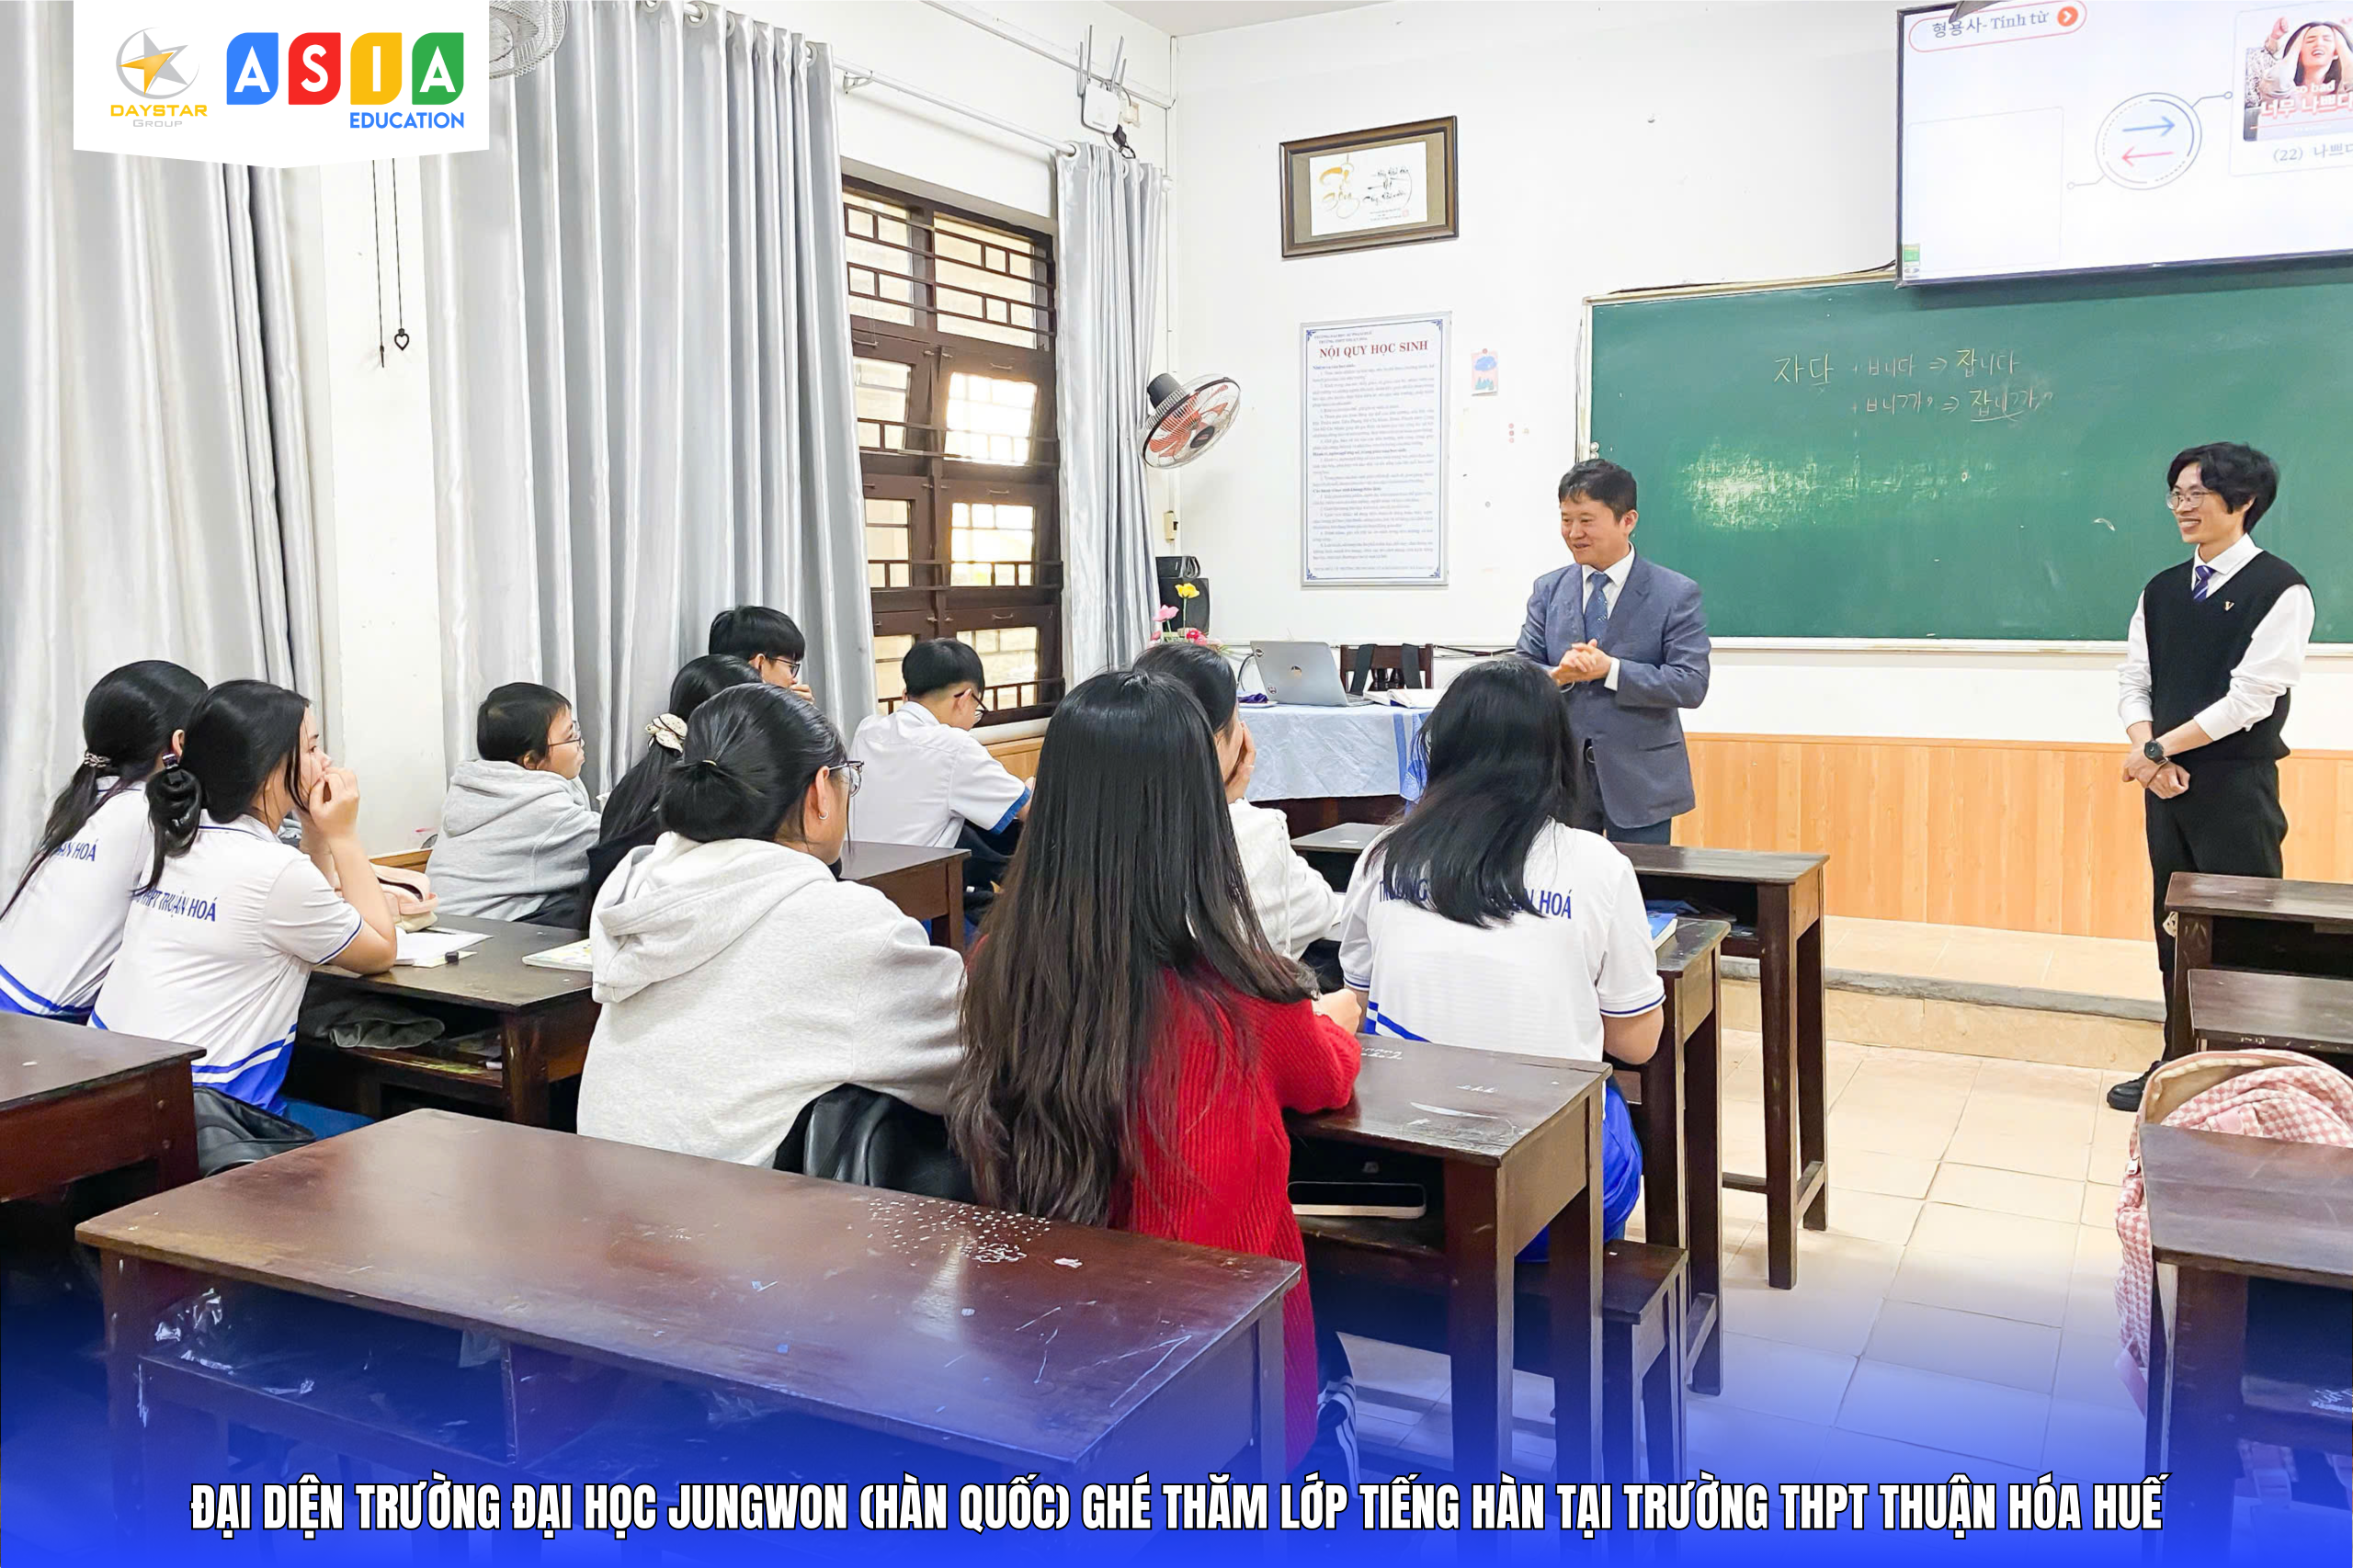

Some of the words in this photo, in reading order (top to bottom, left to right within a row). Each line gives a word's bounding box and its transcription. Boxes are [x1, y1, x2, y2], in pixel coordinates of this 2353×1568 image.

[1990, 13, 2027, 30] Tính
[2311, 79, 2336, 93] bad
[2261, 97, 2297, 119] 너무
[2273, 147, 2304, 165] (22)
[1319, 345, 1340, 359] NỘI
[1343, 346, 1368, 358] QUY
[1370, 343, 1396, 357] HỌC
[1398, 340, 1428, 352] SINH
[1955, 347, 2021, 378] 잡니다
[71, 838, 99, 862] HOÁ
[187, 896, 218, 922] HOÁ
[1539, 889, 1573, 920] HOÁ
